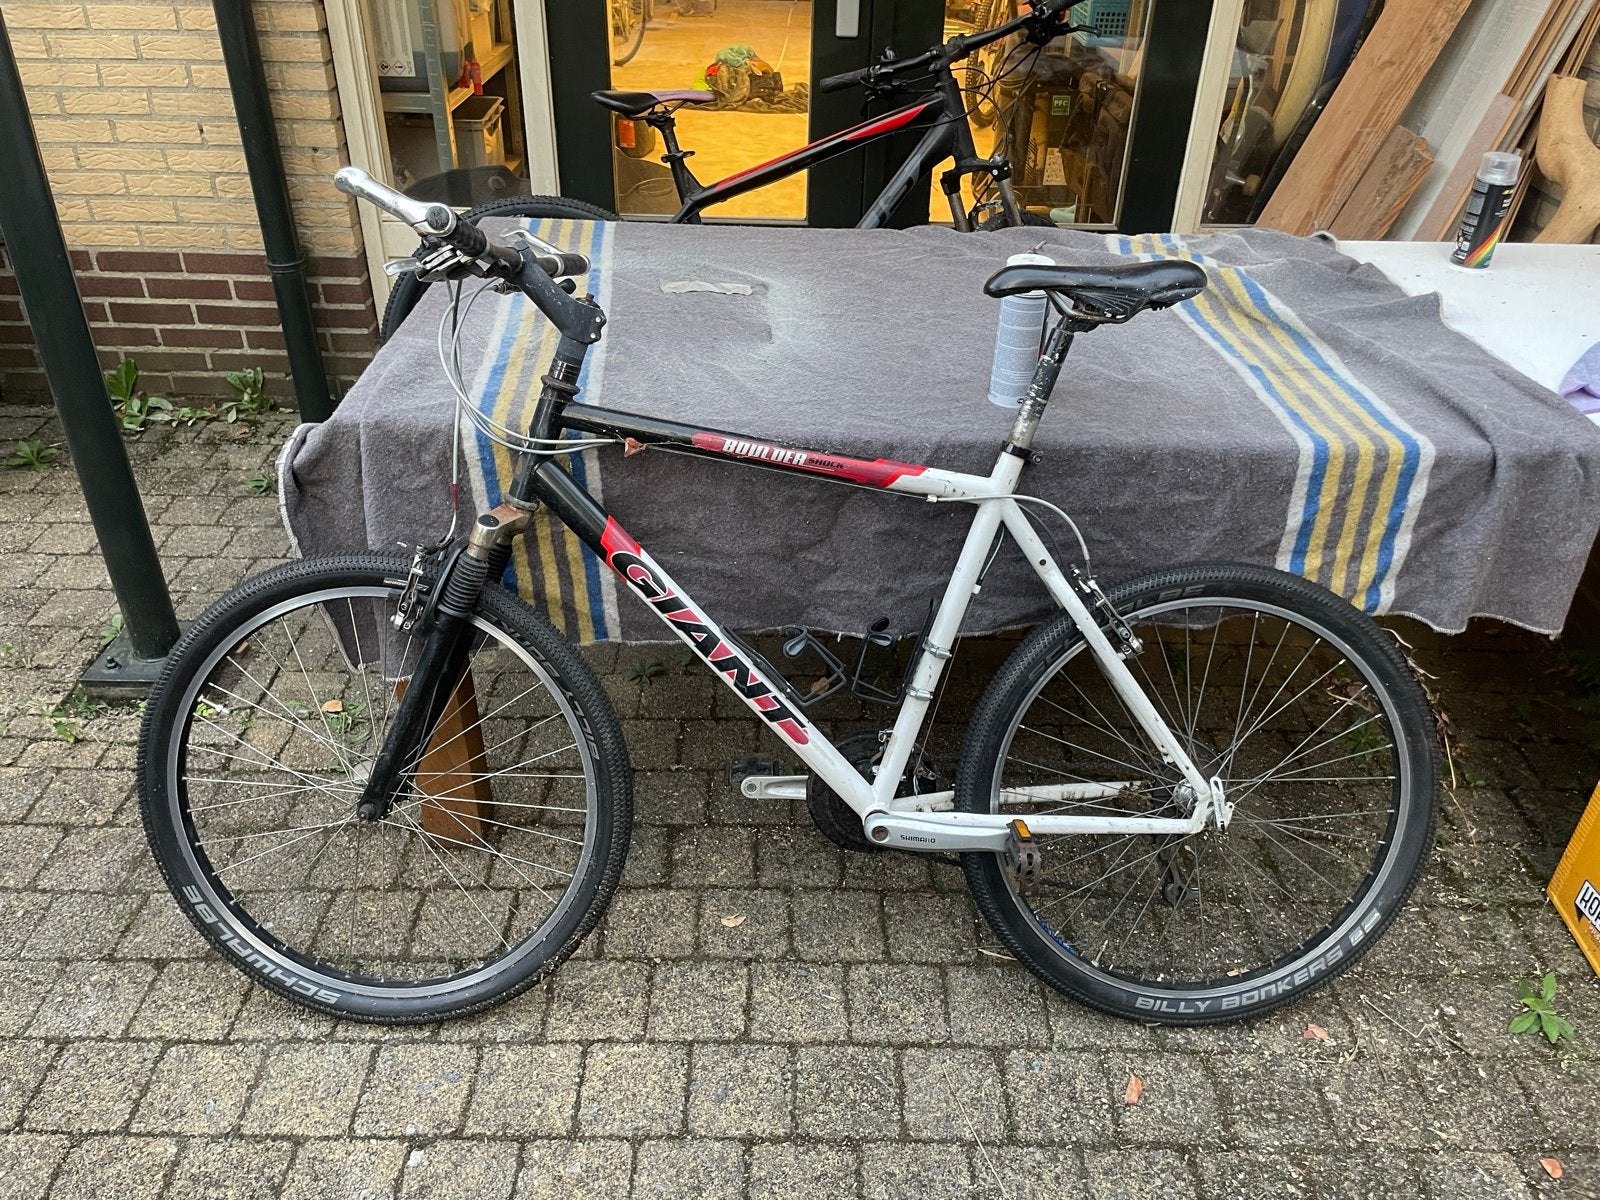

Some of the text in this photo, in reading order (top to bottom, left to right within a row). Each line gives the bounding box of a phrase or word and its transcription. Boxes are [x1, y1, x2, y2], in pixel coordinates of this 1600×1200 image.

[721, 438, 845, 469] BOULDER SHOCK
[611, 551, 807, 729] GIANT
[559, 686, 600, 760] BILLY
[182, 884, 341, 1004] SCHWALBE
[1135, 944, 1344, 1013] BILLY BONKERS
